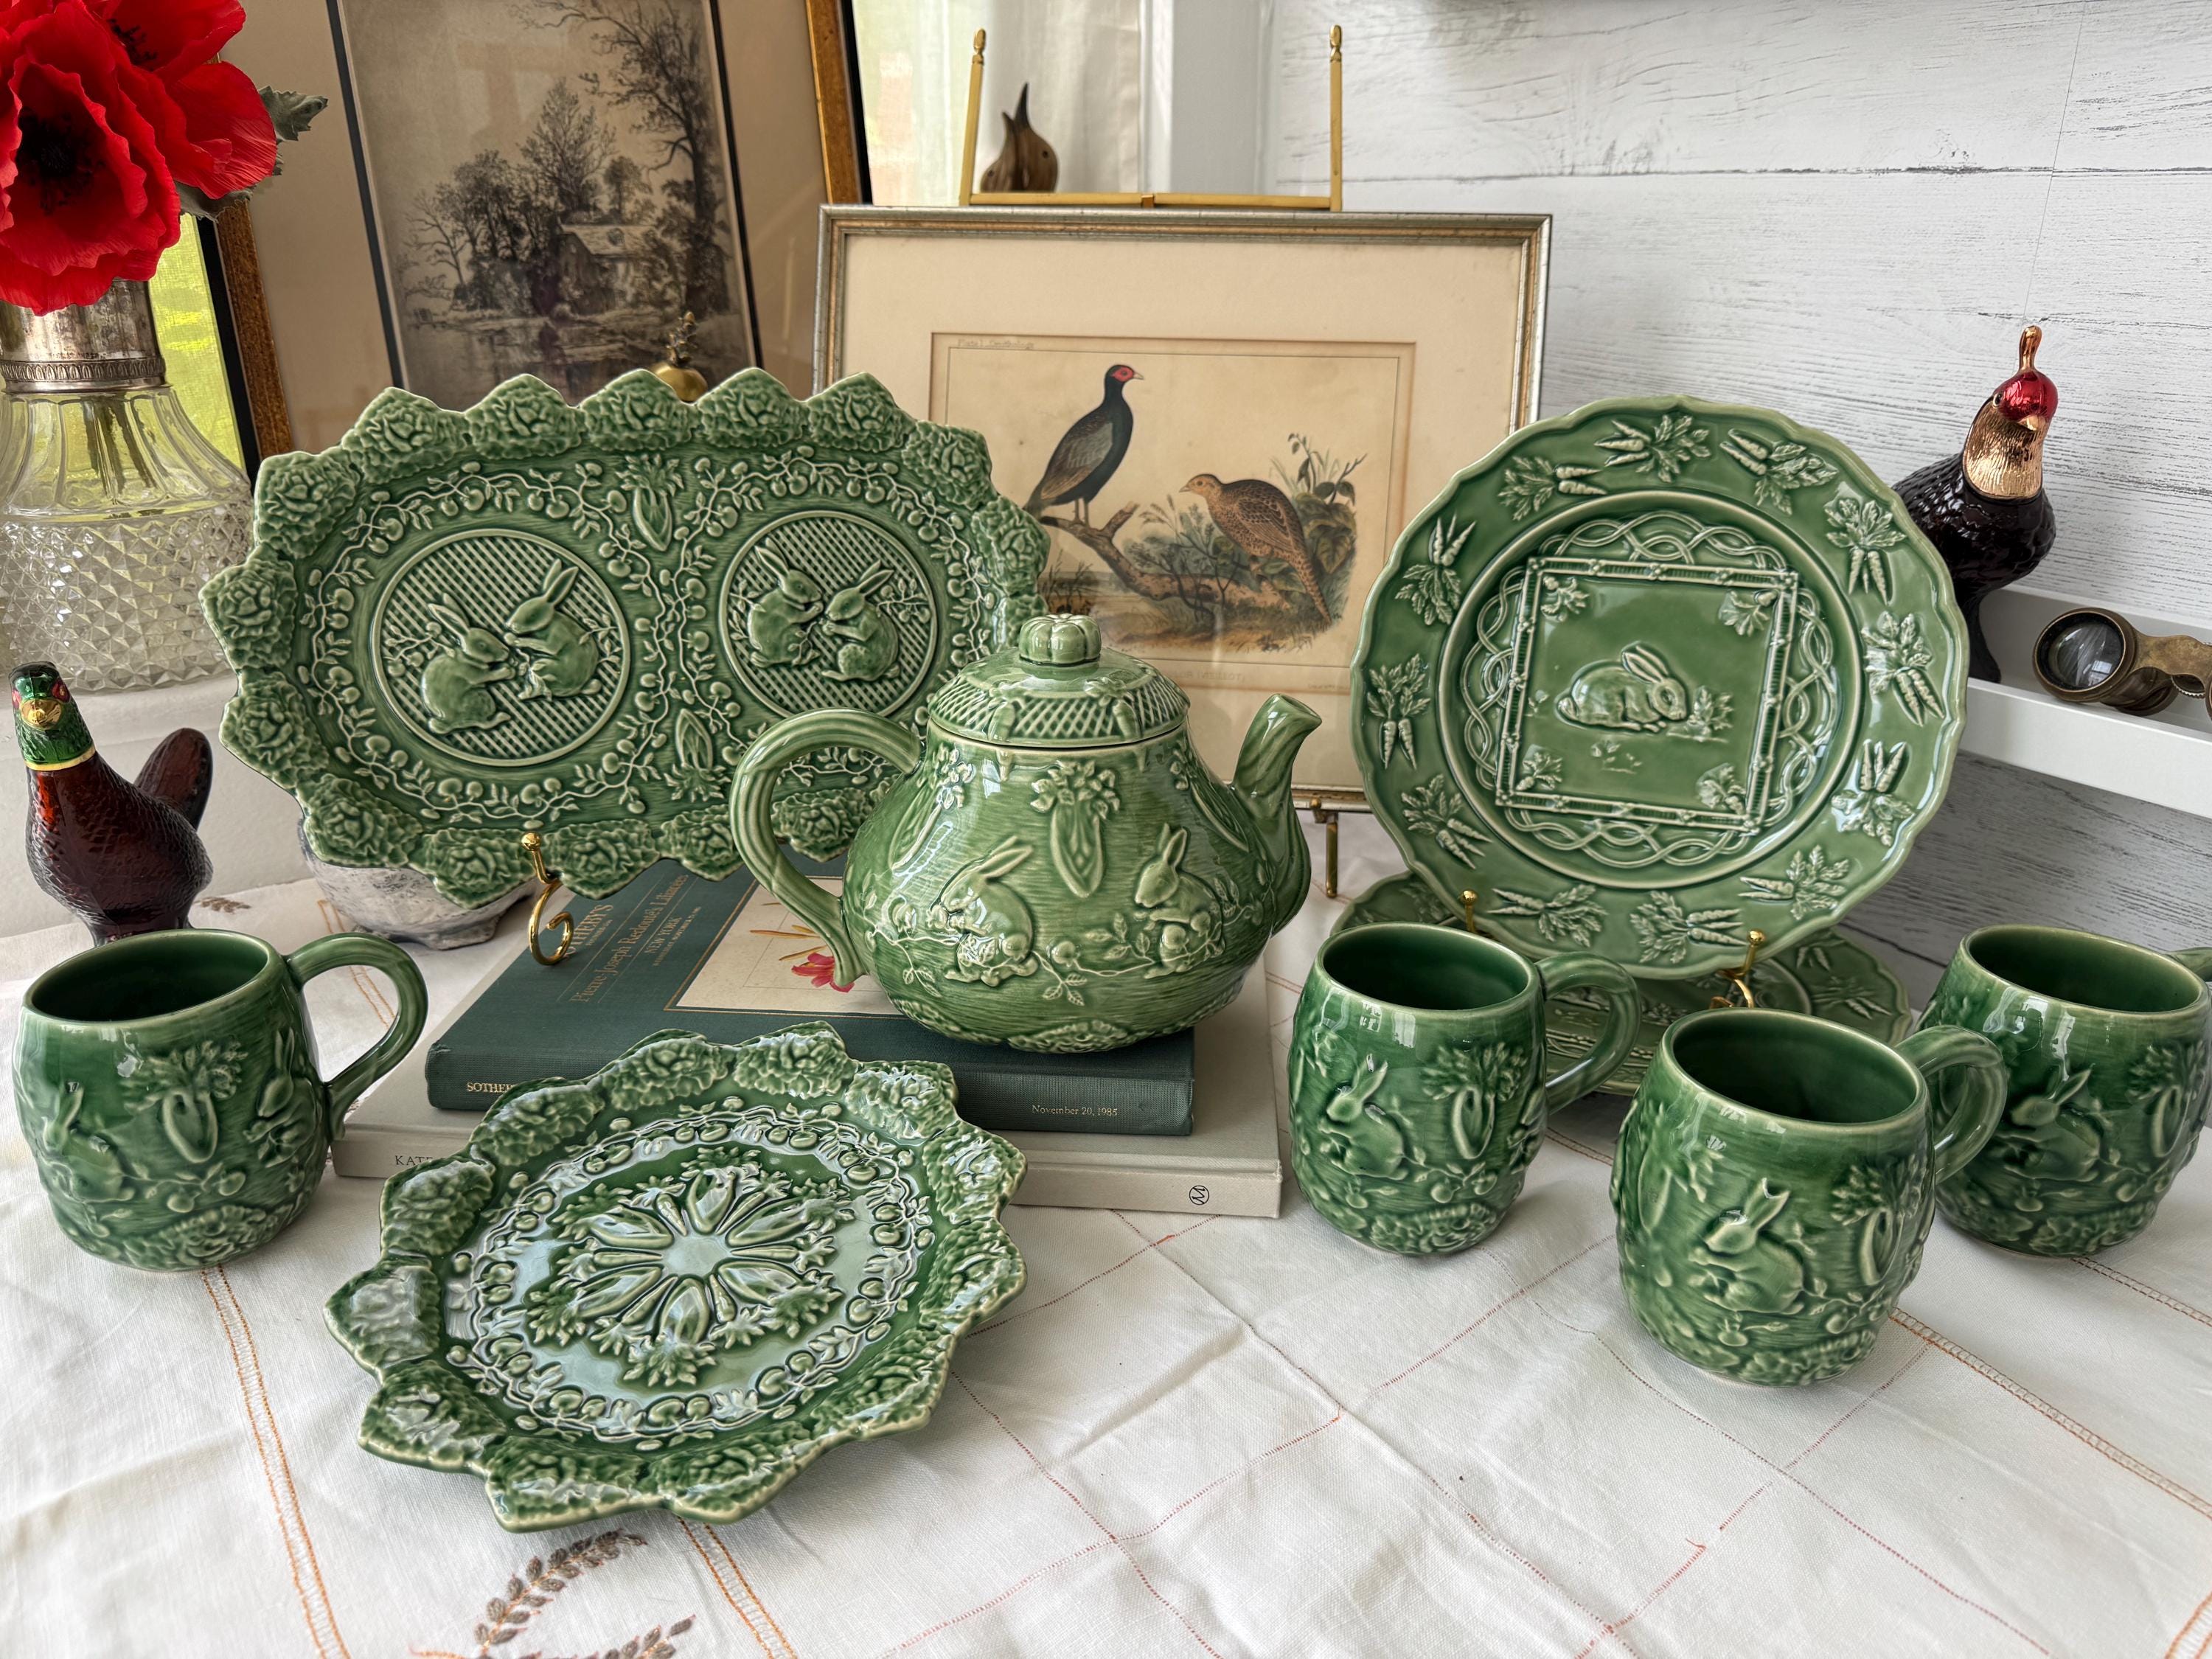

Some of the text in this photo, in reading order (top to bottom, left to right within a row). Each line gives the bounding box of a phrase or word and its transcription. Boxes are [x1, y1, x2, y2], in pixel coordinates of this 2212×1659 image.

[563, 904, 614, 958] OTHEBY'S
[644, 938, 665, 953] NEW
[657, 917, 683, 936] YORK
[568, 946, 633, 1002] Pierre-Joseph
[1032, 1105, 1118, 1116] November 20, 1985
[395, 1155, 434, 1166] KAT
